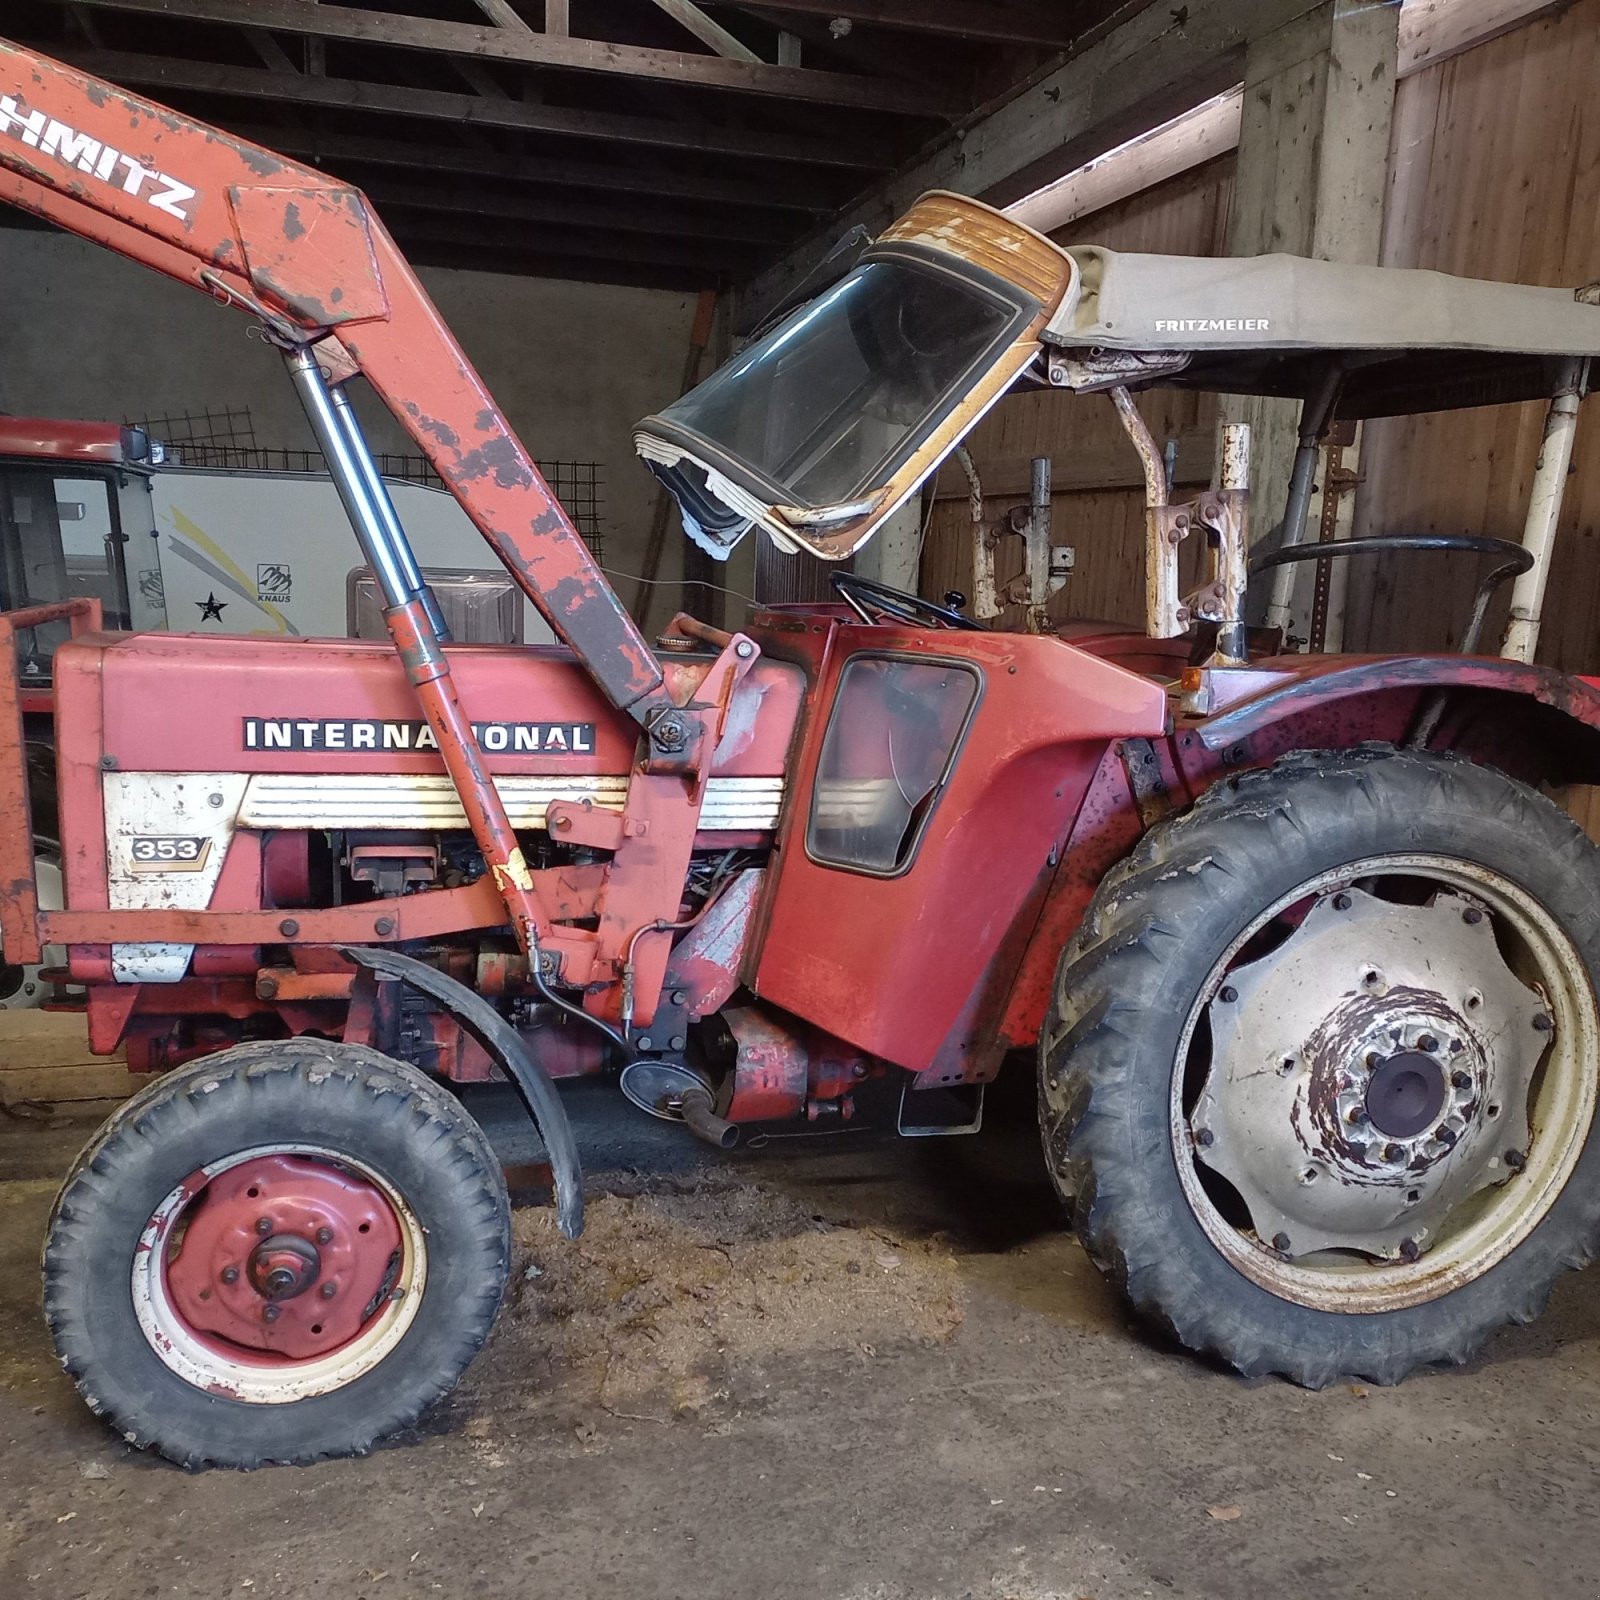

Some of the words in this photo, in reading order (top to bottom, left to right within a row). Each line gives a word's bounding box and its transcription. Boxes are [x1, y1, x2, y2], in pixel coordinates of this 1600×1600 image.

[1155, 319, 1269, 331] FRITZMEIER
[257, 595, 291, 603] KNAUS
[246, 721, 591, 751] INTERNAONAL
[135, 840, 197, 859] 353
